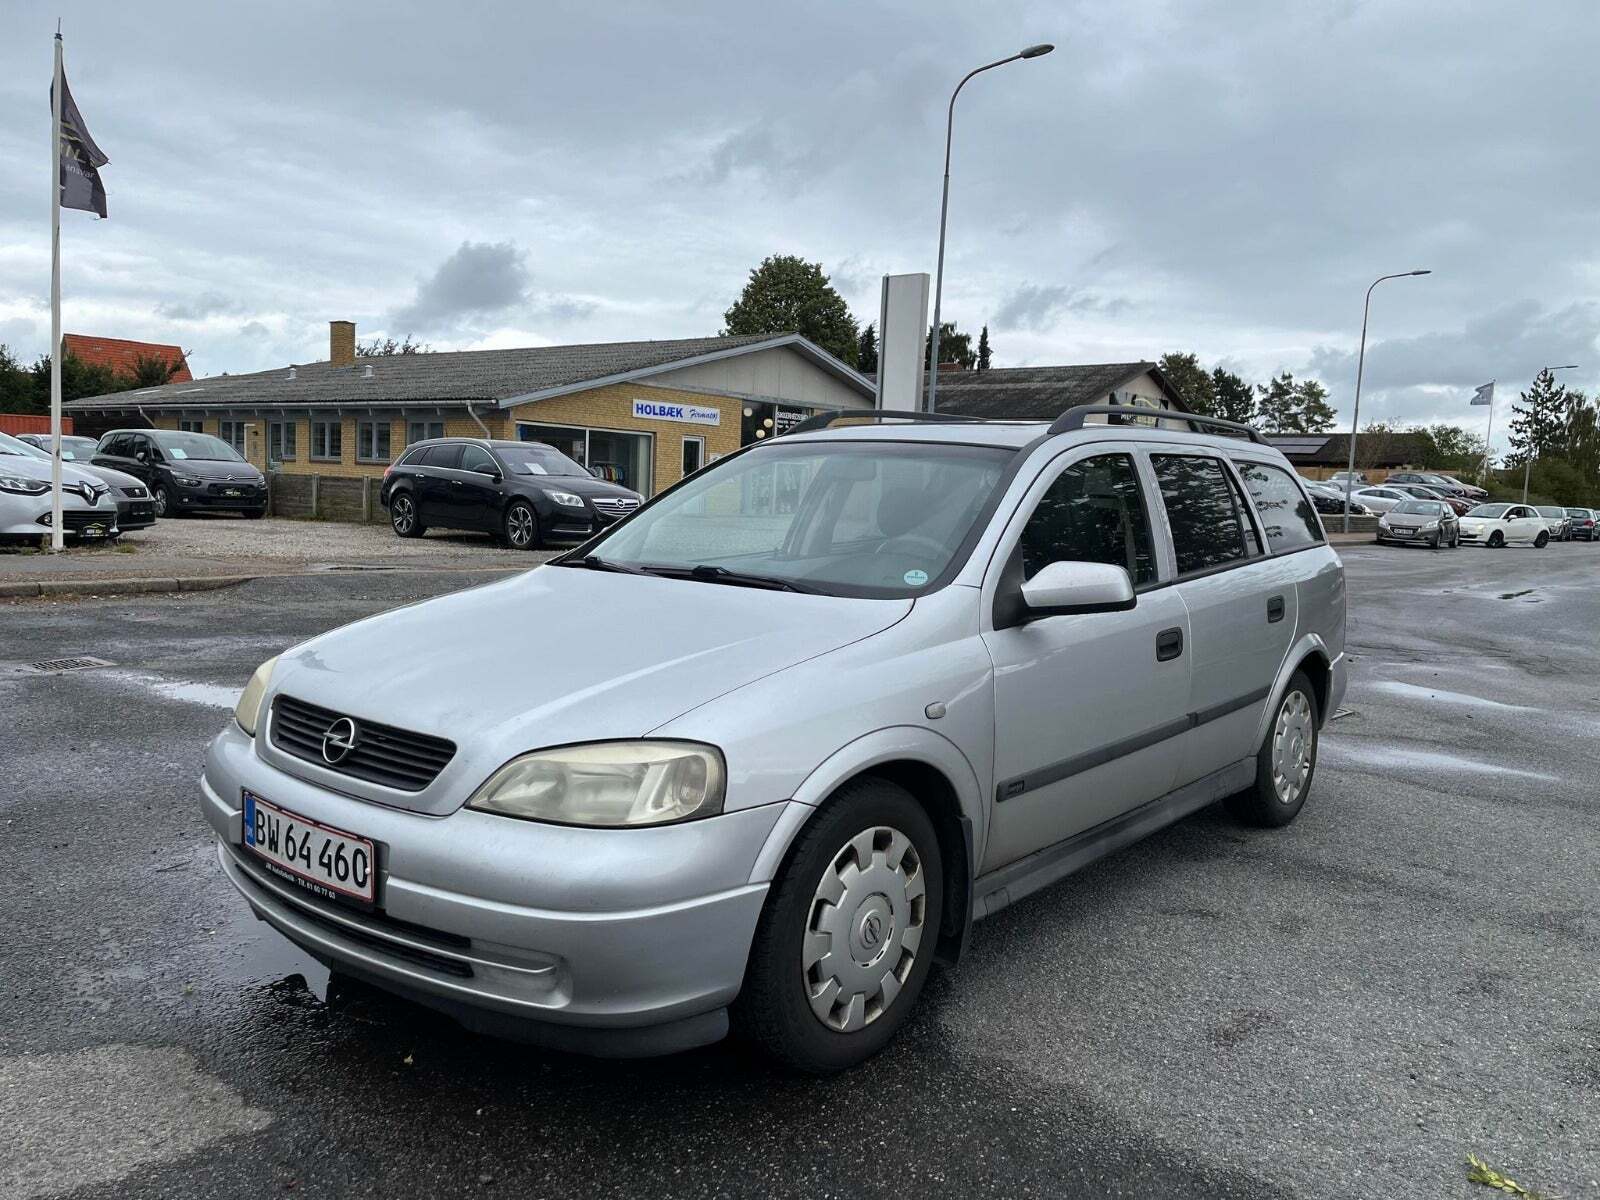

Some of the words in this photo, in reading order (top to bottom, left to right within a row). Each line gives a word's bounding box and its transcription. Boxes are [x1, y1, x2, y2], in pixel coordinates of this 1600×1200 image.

[636, 403, 684, 419] HOLBÆK
[256, 808, 280, 854] BW
[285, 823, 311, 869] 64
[319, 838, 368, 888] 460
